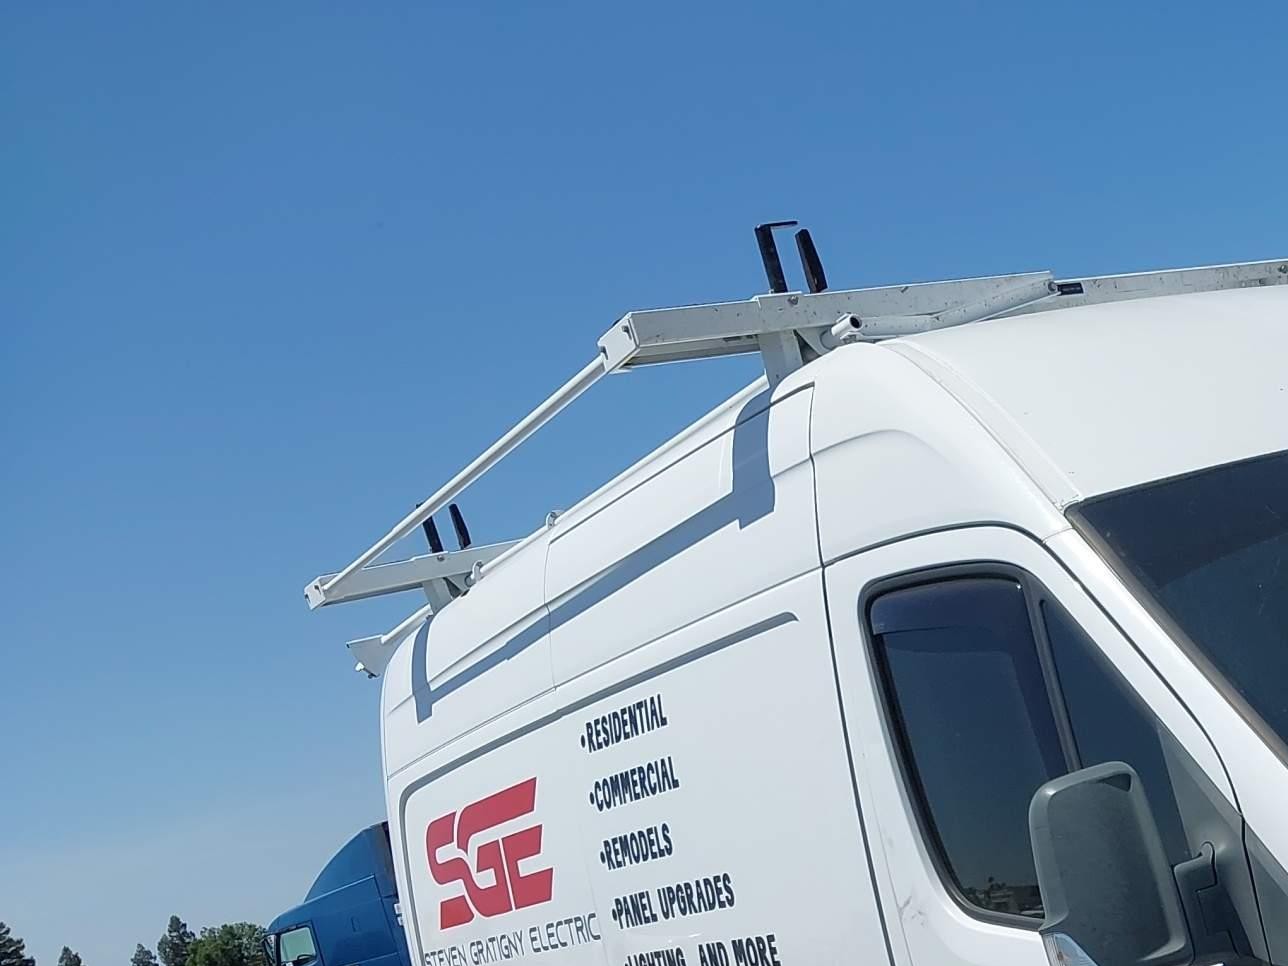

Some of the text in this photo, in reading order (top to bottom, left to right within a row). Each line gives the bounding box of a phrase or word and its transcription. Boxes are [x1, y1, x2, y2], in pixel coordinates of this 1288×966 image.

[585, 694, 668, 753] RESIDENTIAL
[594, 756, 680, 812] COMMERCIAL
[426, 776, 554, 931] SGE
[603, 823, 673, 870] REMODELS
[614, 873, 735, 929] PANEL UPGRADES
[469, 929, 525, 966] GRATIGNY
[529, 912, 601, 953] ELECTRIC
